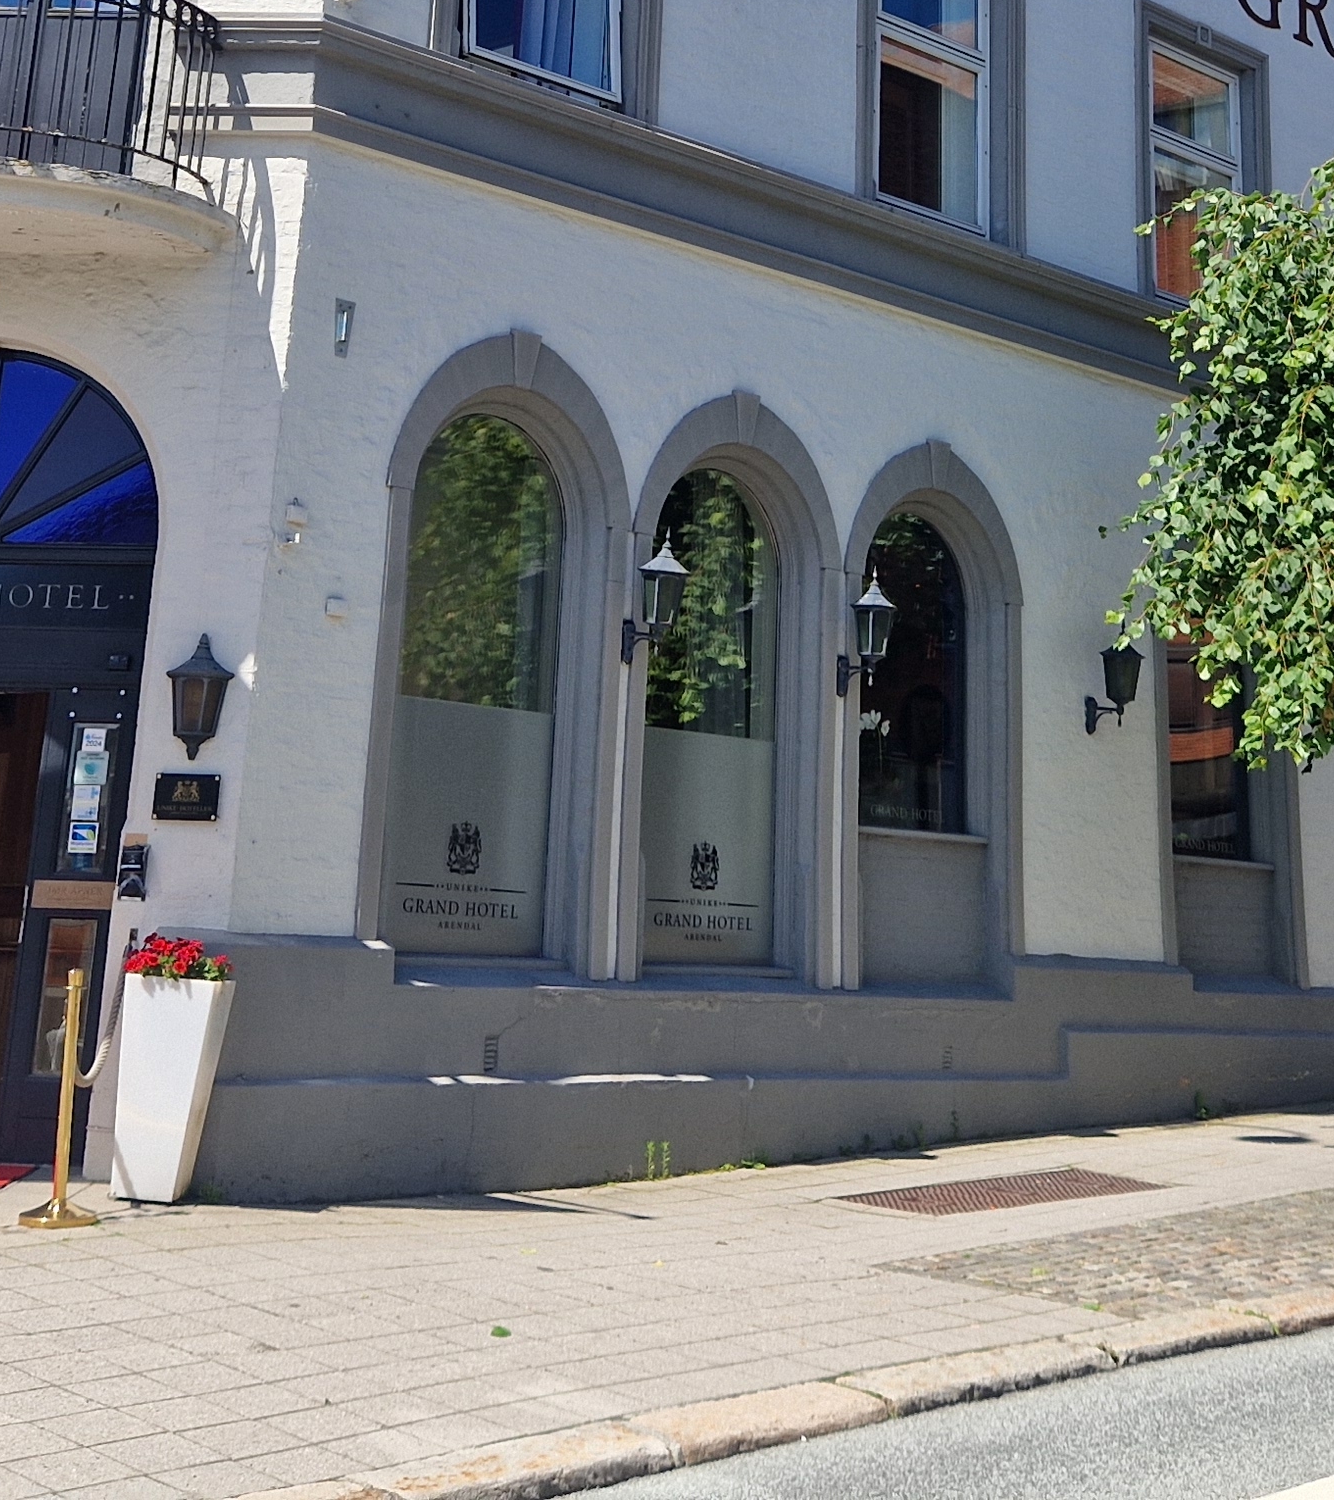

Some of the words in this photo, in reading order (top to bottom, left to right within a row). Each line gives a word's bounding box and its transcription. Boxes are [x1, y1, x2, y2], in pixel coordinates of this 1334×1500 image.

[870, 804, 908, 820] GRAND
[446, 883, 479, 893] UNIKE
[690, 898, 718, 907] UNIKE
[402, 897, 460, 916] GRAND
[465, 901, 519, 920] HOTEL
[437, 921, 482, 931] ARENDAL
[653, 912, 702, 929] GRAND
[707, 915, 753, 931] HOTEL
[684, 933, 722, 942] ARENDAL
